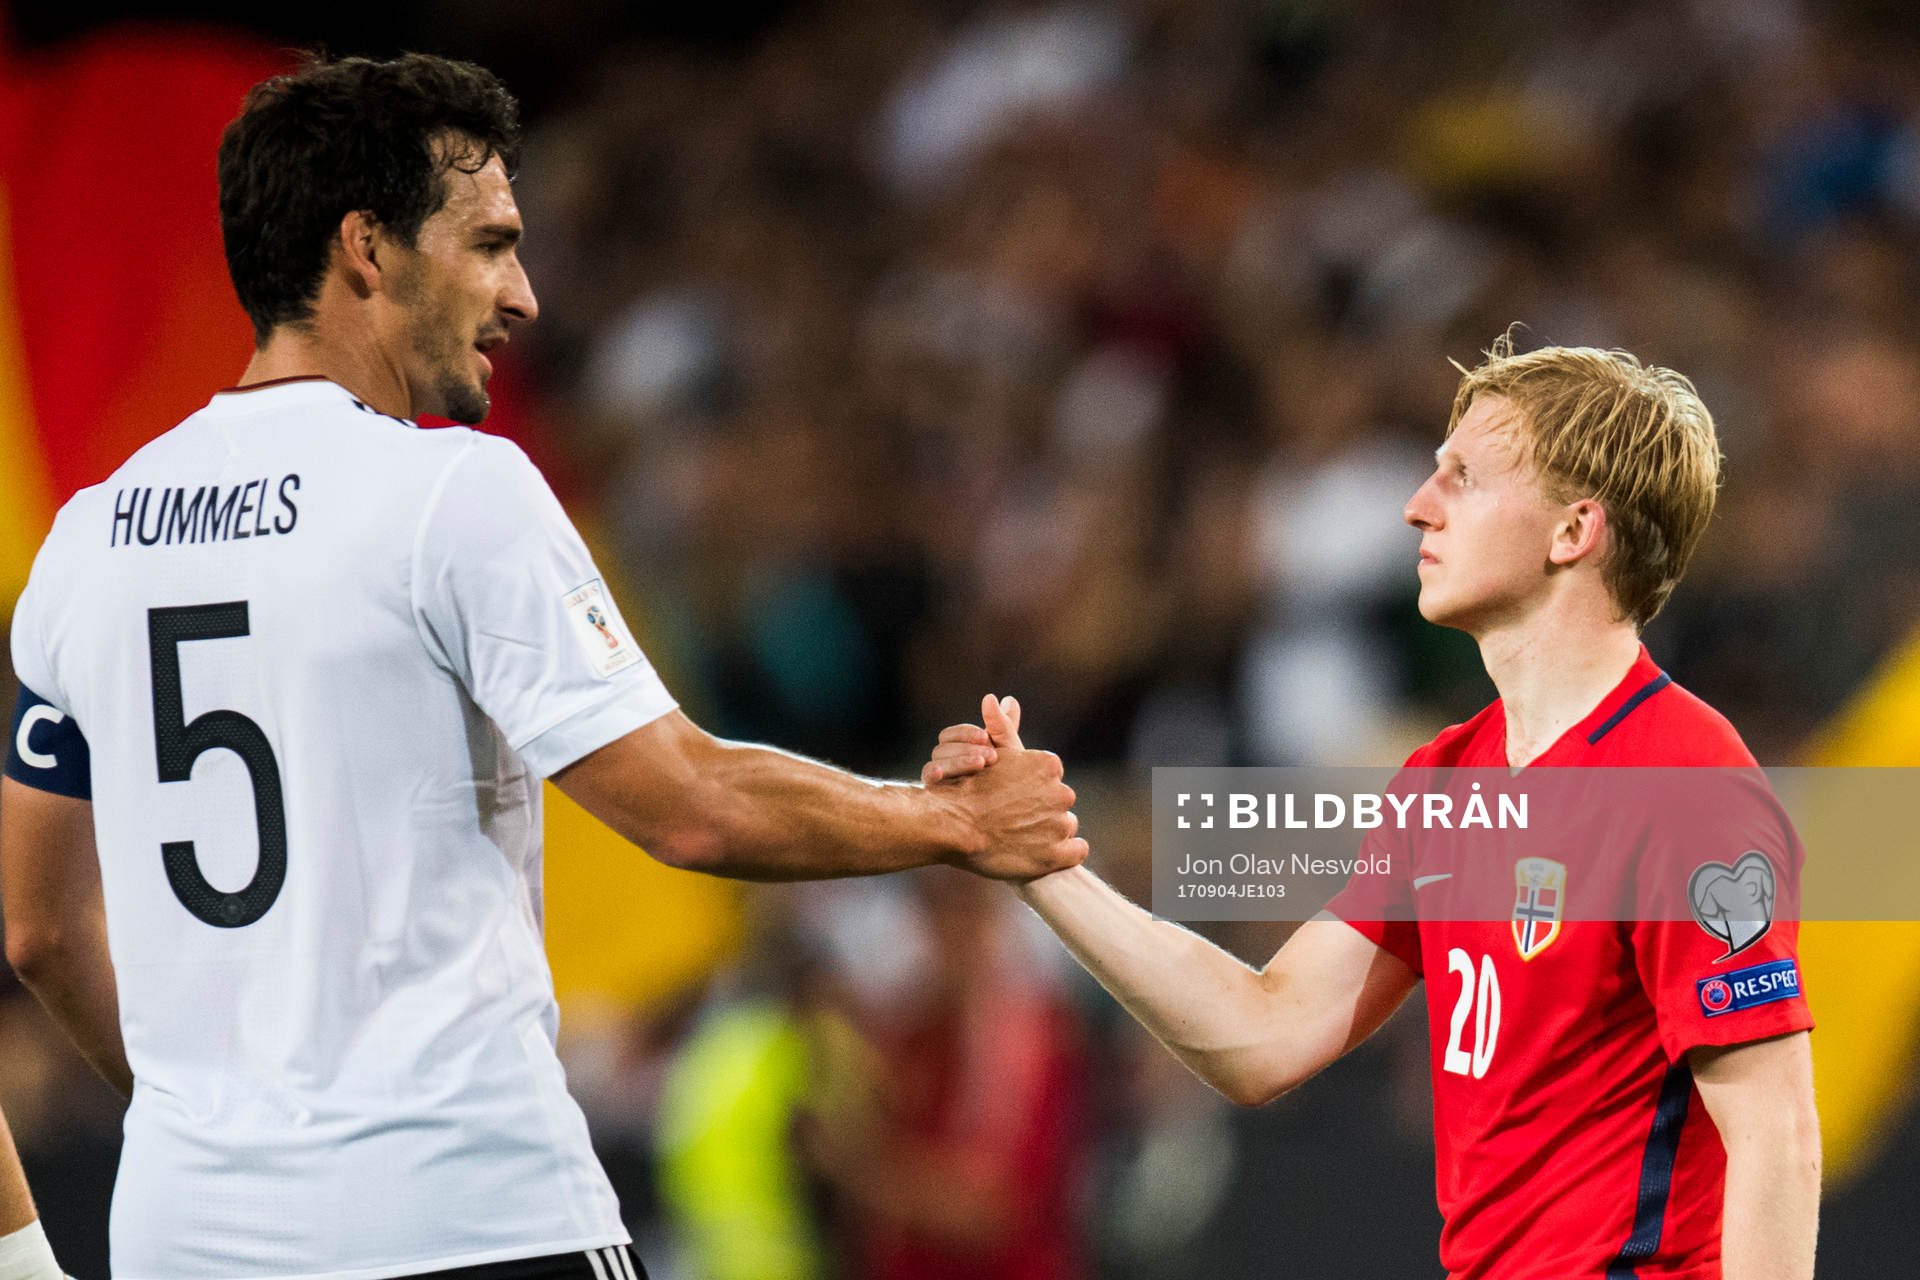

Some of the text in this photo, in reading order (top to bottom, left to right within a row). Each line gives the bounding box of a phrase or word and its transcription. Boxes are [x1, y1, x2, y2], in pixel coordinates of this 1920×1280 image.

[111, 473, 301, 548] HUMMELS
[16, 704, 66, 768] C
[147, 600, 288, 928] 5
[1443, 948, 1501, 1080] 20
[1733, 969, 1797, 999] RESPECT
